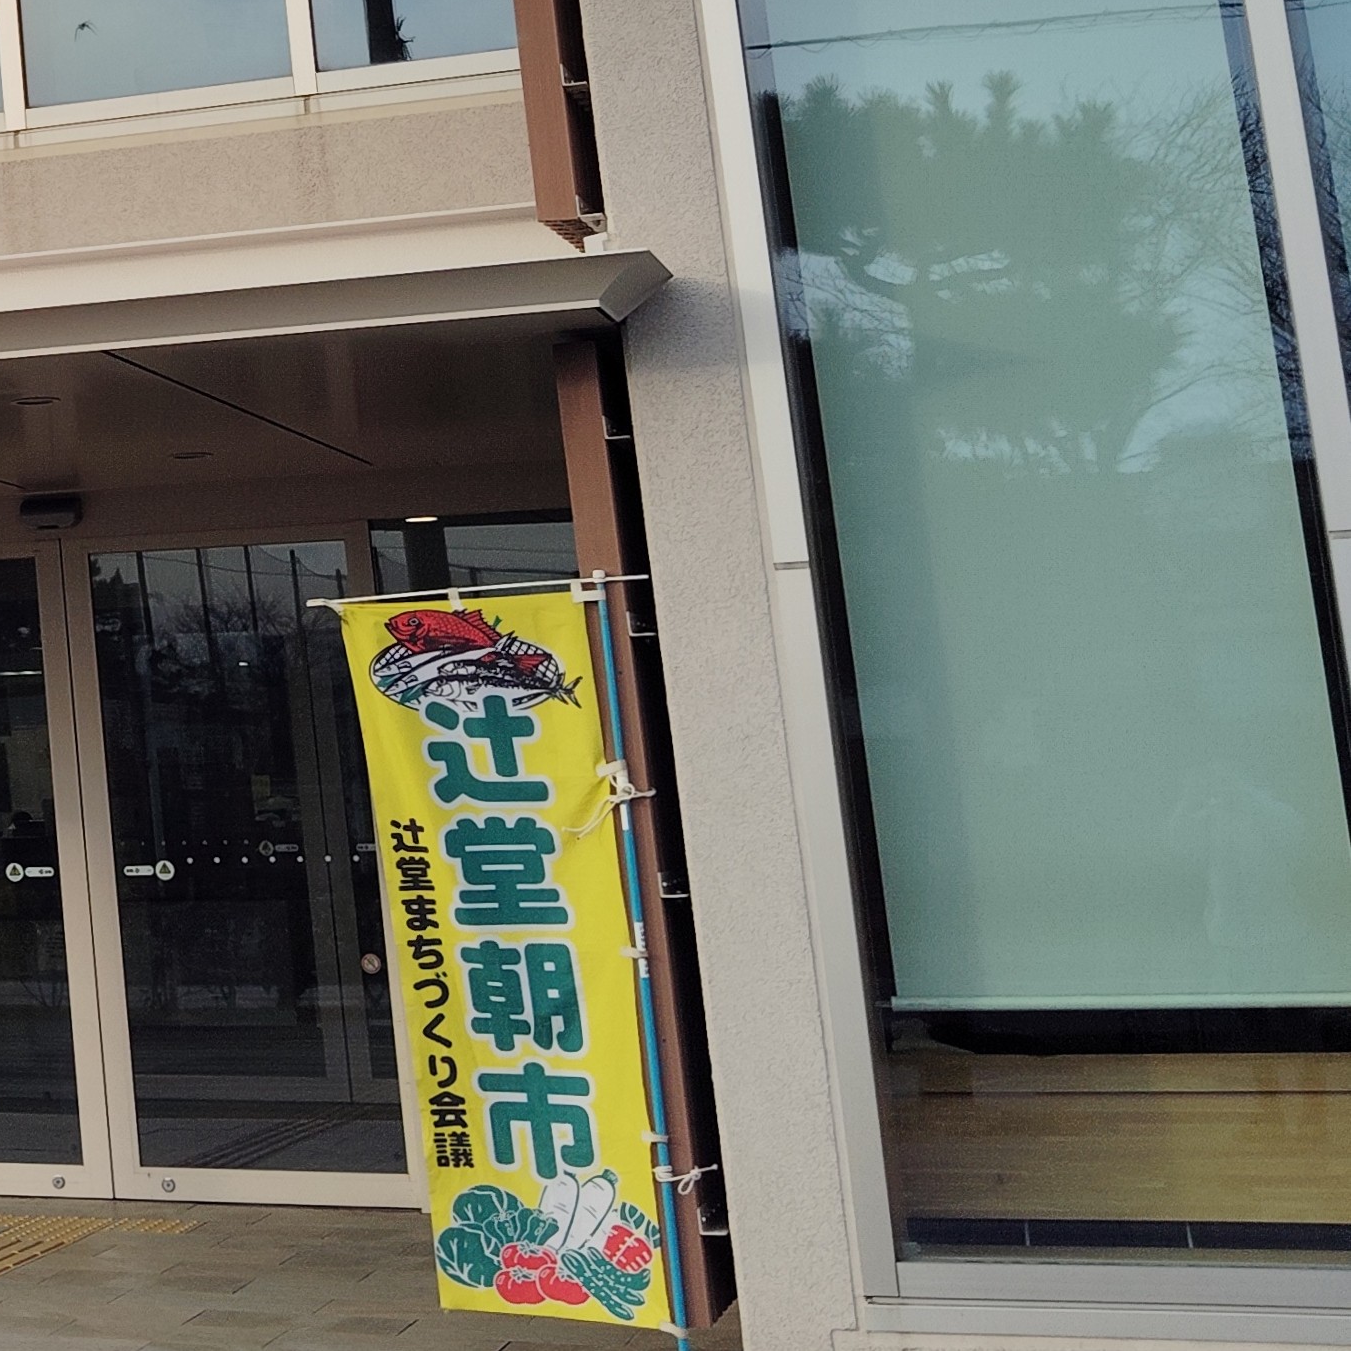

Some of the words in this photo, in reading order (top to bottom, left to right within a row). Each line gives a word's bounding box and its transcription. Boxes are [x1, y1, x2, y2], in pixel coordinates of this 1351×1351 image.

[390, 818, 474, 1169] 辻堂まちづくり会議
[424, 694, 595, 1179] 辻堂朝市
